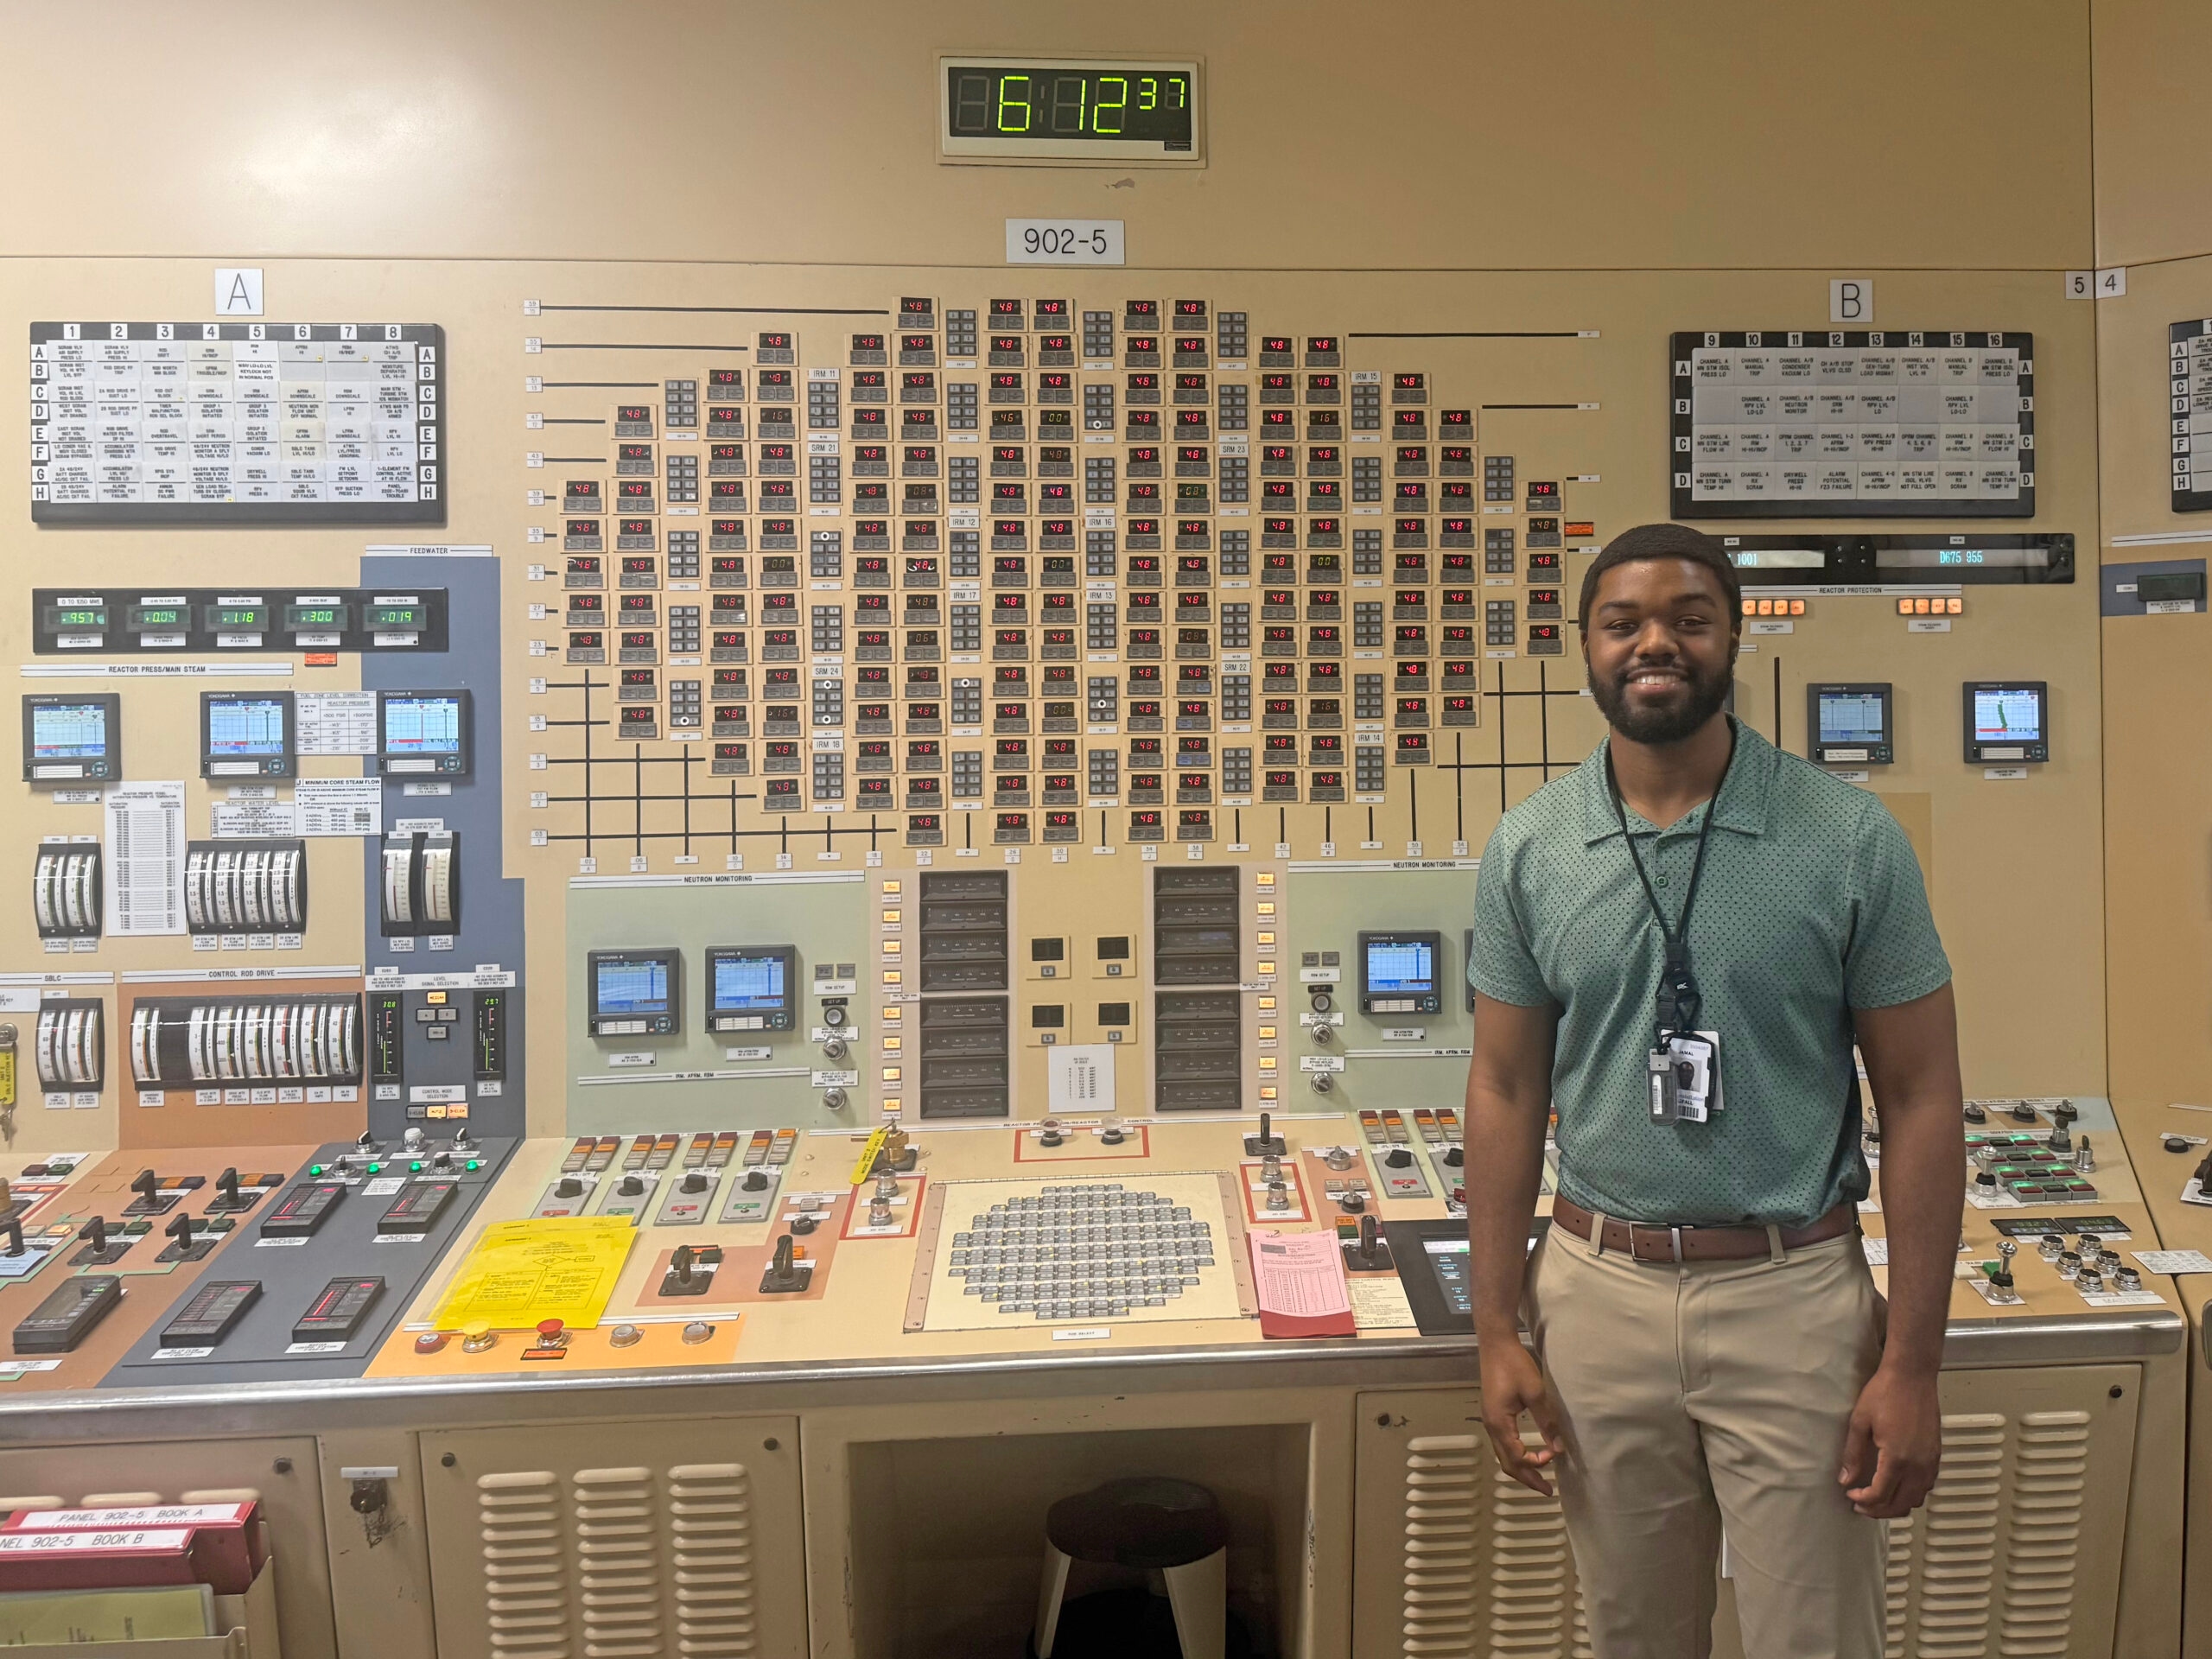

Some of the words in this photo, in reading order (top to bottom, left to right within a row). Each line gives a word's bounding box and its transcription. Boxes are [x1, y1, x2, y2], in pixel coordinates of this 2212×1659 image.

[1139, 78, 1185, 111] 37
[1024, 227, 1107, 255] 902-5
[2074, 276, 2085, 294] 5
[2105, 274, 2117, 291] 4
[227, 272, 252, 311] A
[1841, 283, 1861, 318] B
[1000, 302, 1013, 312] 48
[70, 326, 74, 338] 1
[116, 325, 123, 337] 2
[162, 325, 169, 338] 3
[207, 325, 215, 337] 4
[253, 326, 261, 338] 5
[299, 326, 307, 338] 6
[345, 326, 353, 338] 7
[390, 326, 397, 338] 8
[1316, 340, 1329, 349] 48
[1707, 334, 1715, 346] 9
[1748, 334, 1758, 345] 10
[1791, 334, 1799, 345] 11
[1831, 334, 1841, 345] 12
[1871, 334, 1881, 345] 13
[1910, 334, 1922, 345] 14
[1953, 334, 1962, 345] 15
[1990, 334, 2000, 345] 16
[35, 346, 43, 358] A
[423, 348, 431, 360] A
[2175, 344, 2183, 355] A
[35, 365, 43, 376] B
[423, 366, 431, 378] B
[1680, 362, 1687, 374] A
[2022, 362, 2029, 373] A
[2176, 361, 2183, 372] B
[720, 373, 733, 382] 48
[1355, 372, 1368, 380] IRM
[1370, 372, 1377, 380] 15
[1402, 377, 1415, 386] 48
[36, 386, 43, 398] C
[2177, 382, 2183, 392] C
[423, 387, 431, 399] C
[1680, 401, 1686, 412] B
[2023, 399, 2029, 410] B
[2177, 399, 2184, 410] D
[36, 405, 43, 417] D
[424, 406, 431, 417] D
[2177, 421, 2183, 432] E
[36, 428, 43, 440] E
[424, 429, 431, 440] E
[1680, 438, 1687, 449] C
[2023, 436, 2030, 448] C
[2177, 439, 2183, 450] F
[36, 447, 43, 458] F
[424, 447, 431, 458] F
[2177, 459, 2185, 471] G
[37, 468, 44, 480] G
[424, 468, 432, 480] G
[1680, 474, 1687, 486] D
[2023, 474, 2030, 486] D
[2177, 477, 2185, 488] H
[36, 487, 44, 499] H
[424, 486, 432, 499] H
[576, 485, 590, 493] 48
[1537, 485, 1549, 493] 48
[952, 518, 966, 526] IRM
[968, 518, 976, 526] 12
[1104, 518, 1112, 526] 16
[1966, 550, 1983, 563] 955
[969, 591, 976, 600] 17
[1105, 591, 1113, 600] 13
[1452, 629, 1465, 639] 48
[815, 667, 827, 676] SRM
[830, 667, 838, 676] 24
[1238, 663, 1247, 671] 22
[725, 710, 738, 719] 48
[1358, 734, 1371, 742] IRM
[1374, 734, 1381, 742] 14
[1406, 738, 1419, 747] 48
[816, 741, 828, 749] IRM
[1393, 861, 1419, 869] NEUTRON
[1421, 860, 1456, 868] MONITORING
[715, 874, 753, 883] MONITORING
[59, 1512, 96, 1522] PANEL
[104, 1510, 145, 1520] 902-5
[156, 1508, 188, 1517] BOOK
[194, 1508, 203, 1516] A
[31, 1535, 74, 1548] 902-5
[92, 1534, 127, 1546] BOOK
[133, 1533, 144, 1544] B
